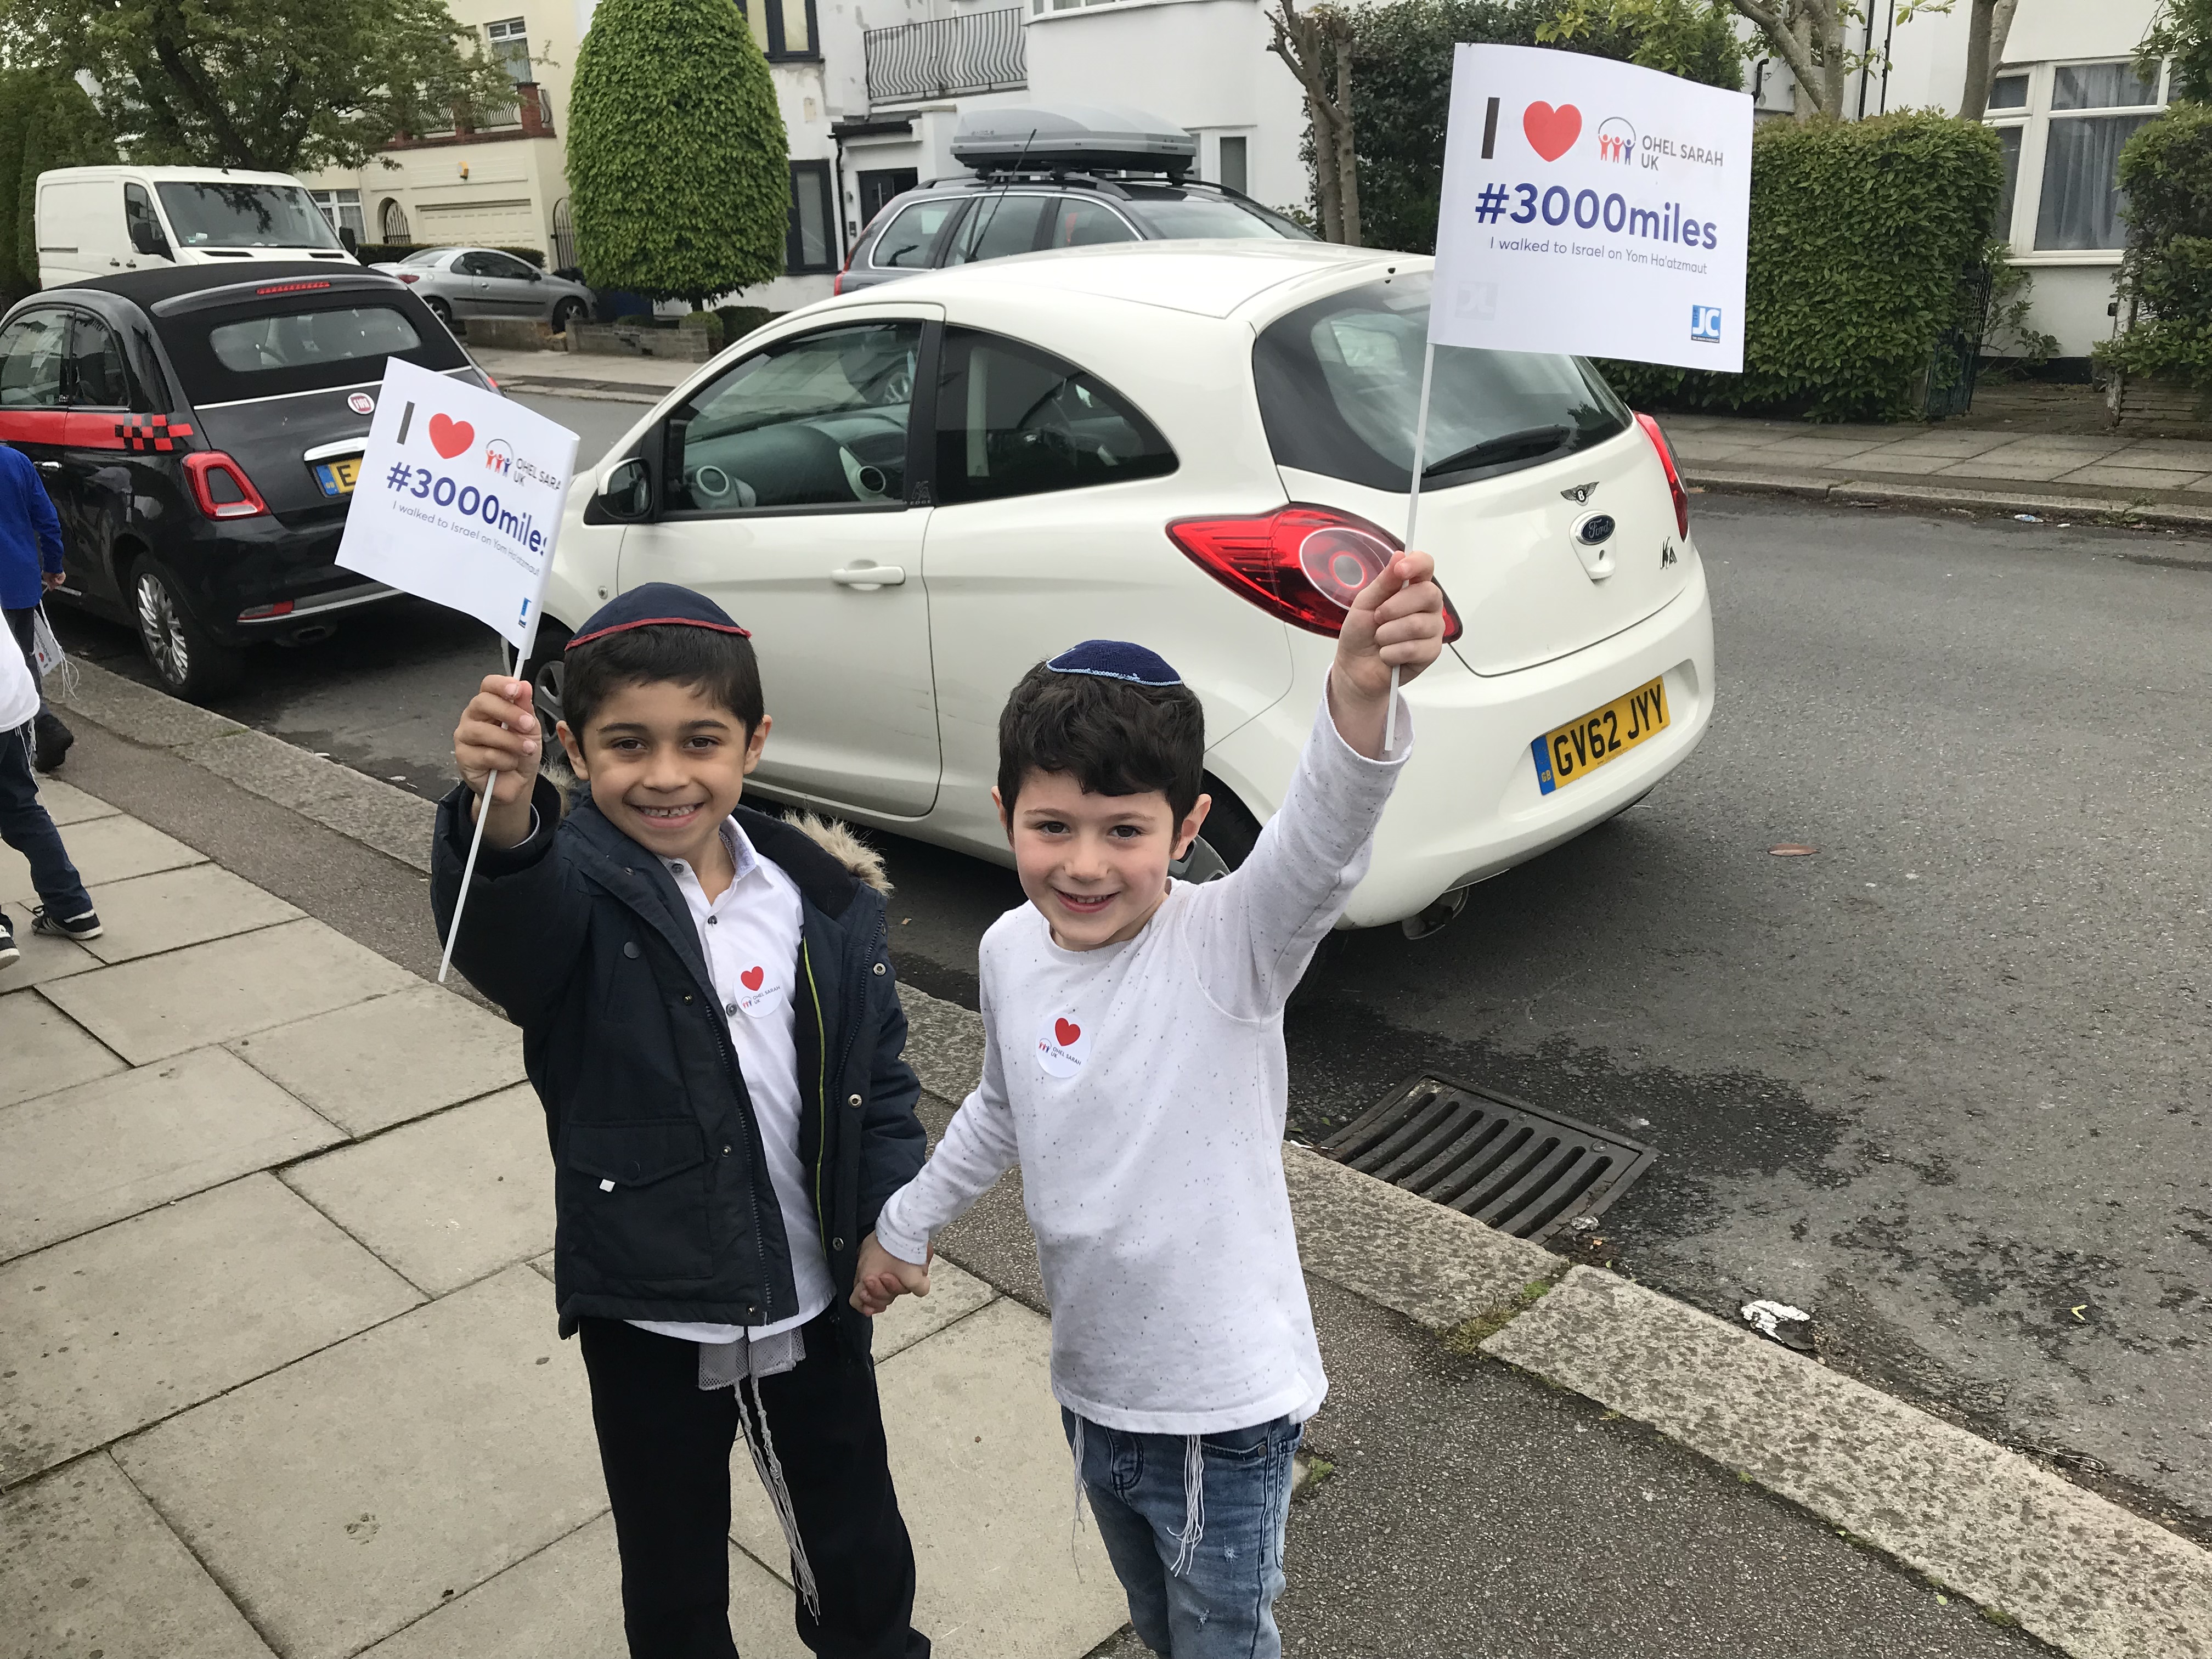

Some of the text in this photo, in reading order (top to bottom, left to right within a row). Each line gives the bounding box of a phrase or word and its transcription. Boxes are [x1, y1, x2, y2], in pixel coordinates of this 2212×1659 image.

[1481, 97, 1500, 159] I
[1641, 153, 1659, 171] UK
[1643, 135, 1723, 167] OHEL SARAH
[1475, 183, 1717, 250] #3000miles
[1490, 236, 1707, 274] I walked to Israel on Yom Ha'atzmaut
[1692, 307, 1720, 336] JC
[397, 401, 415, 445] I
[514, 471, 526, 487] UK
[516, 458, 537, 479] OHEL
[392, 500, 397, 509] I
[399, 504, 436, 523] walked
[437, 517, 448, 528] to
[451, 522, 479, 539] Israel
[481, 534, 492, 545] on
[493, 538, 507, 555] Yom
[1589, 518, 1609, 538] Ford
[1554, 684, 1662, 776] GV62 JYY
[765, 986, 780, 995] SARAH
[1053, 1047, 1081, 1065] OHEL SARAH
